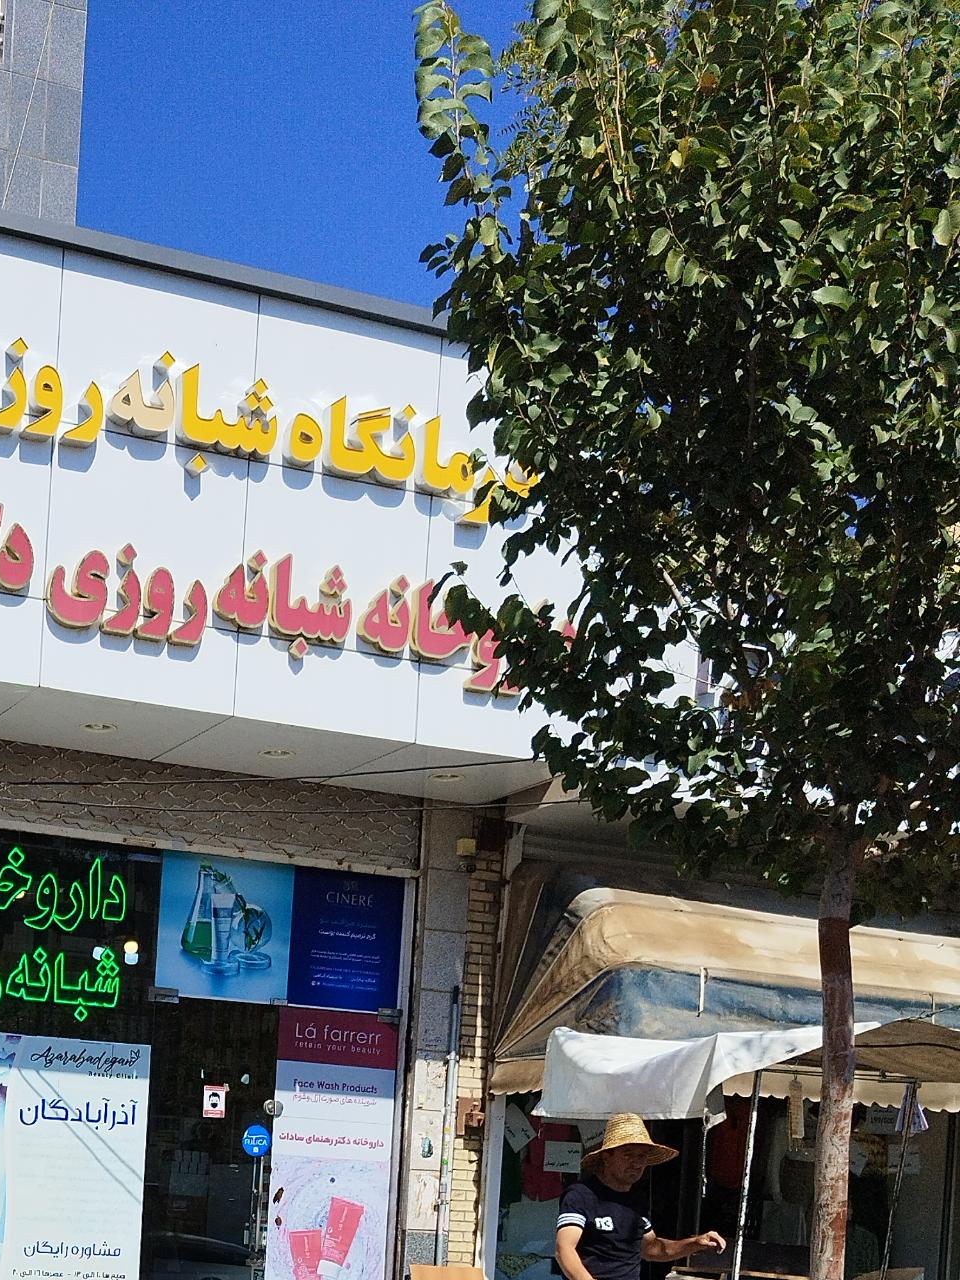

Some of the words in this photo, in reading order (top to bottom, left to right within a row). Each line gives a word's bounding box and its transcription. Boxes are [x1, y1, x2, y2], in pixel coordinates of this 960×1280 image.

[107, 350, 277, 477] شبانه
[46, 543, 206, 648] روزی
[214, 550, 353, 659] شبانه
[6, 947, 119, 1022] شبانه
[324, 1024, 382, 1045] farrerr
[351, 1045, 381, 1055] beauty
[293, 1079, 315, 1088] Face
[317, 1081, 340, 1091] Wash
[342, 1082, 378, 1094] Products
[279, 1132, 305, 1142] سادات
[334, 1137, 352, 1146] دکتر
[353, 1137, 384, 1149] داروخانه
[23, 1240, 69, 1258] رایگان
[71, 1241, 121, 1259] مشاوره
